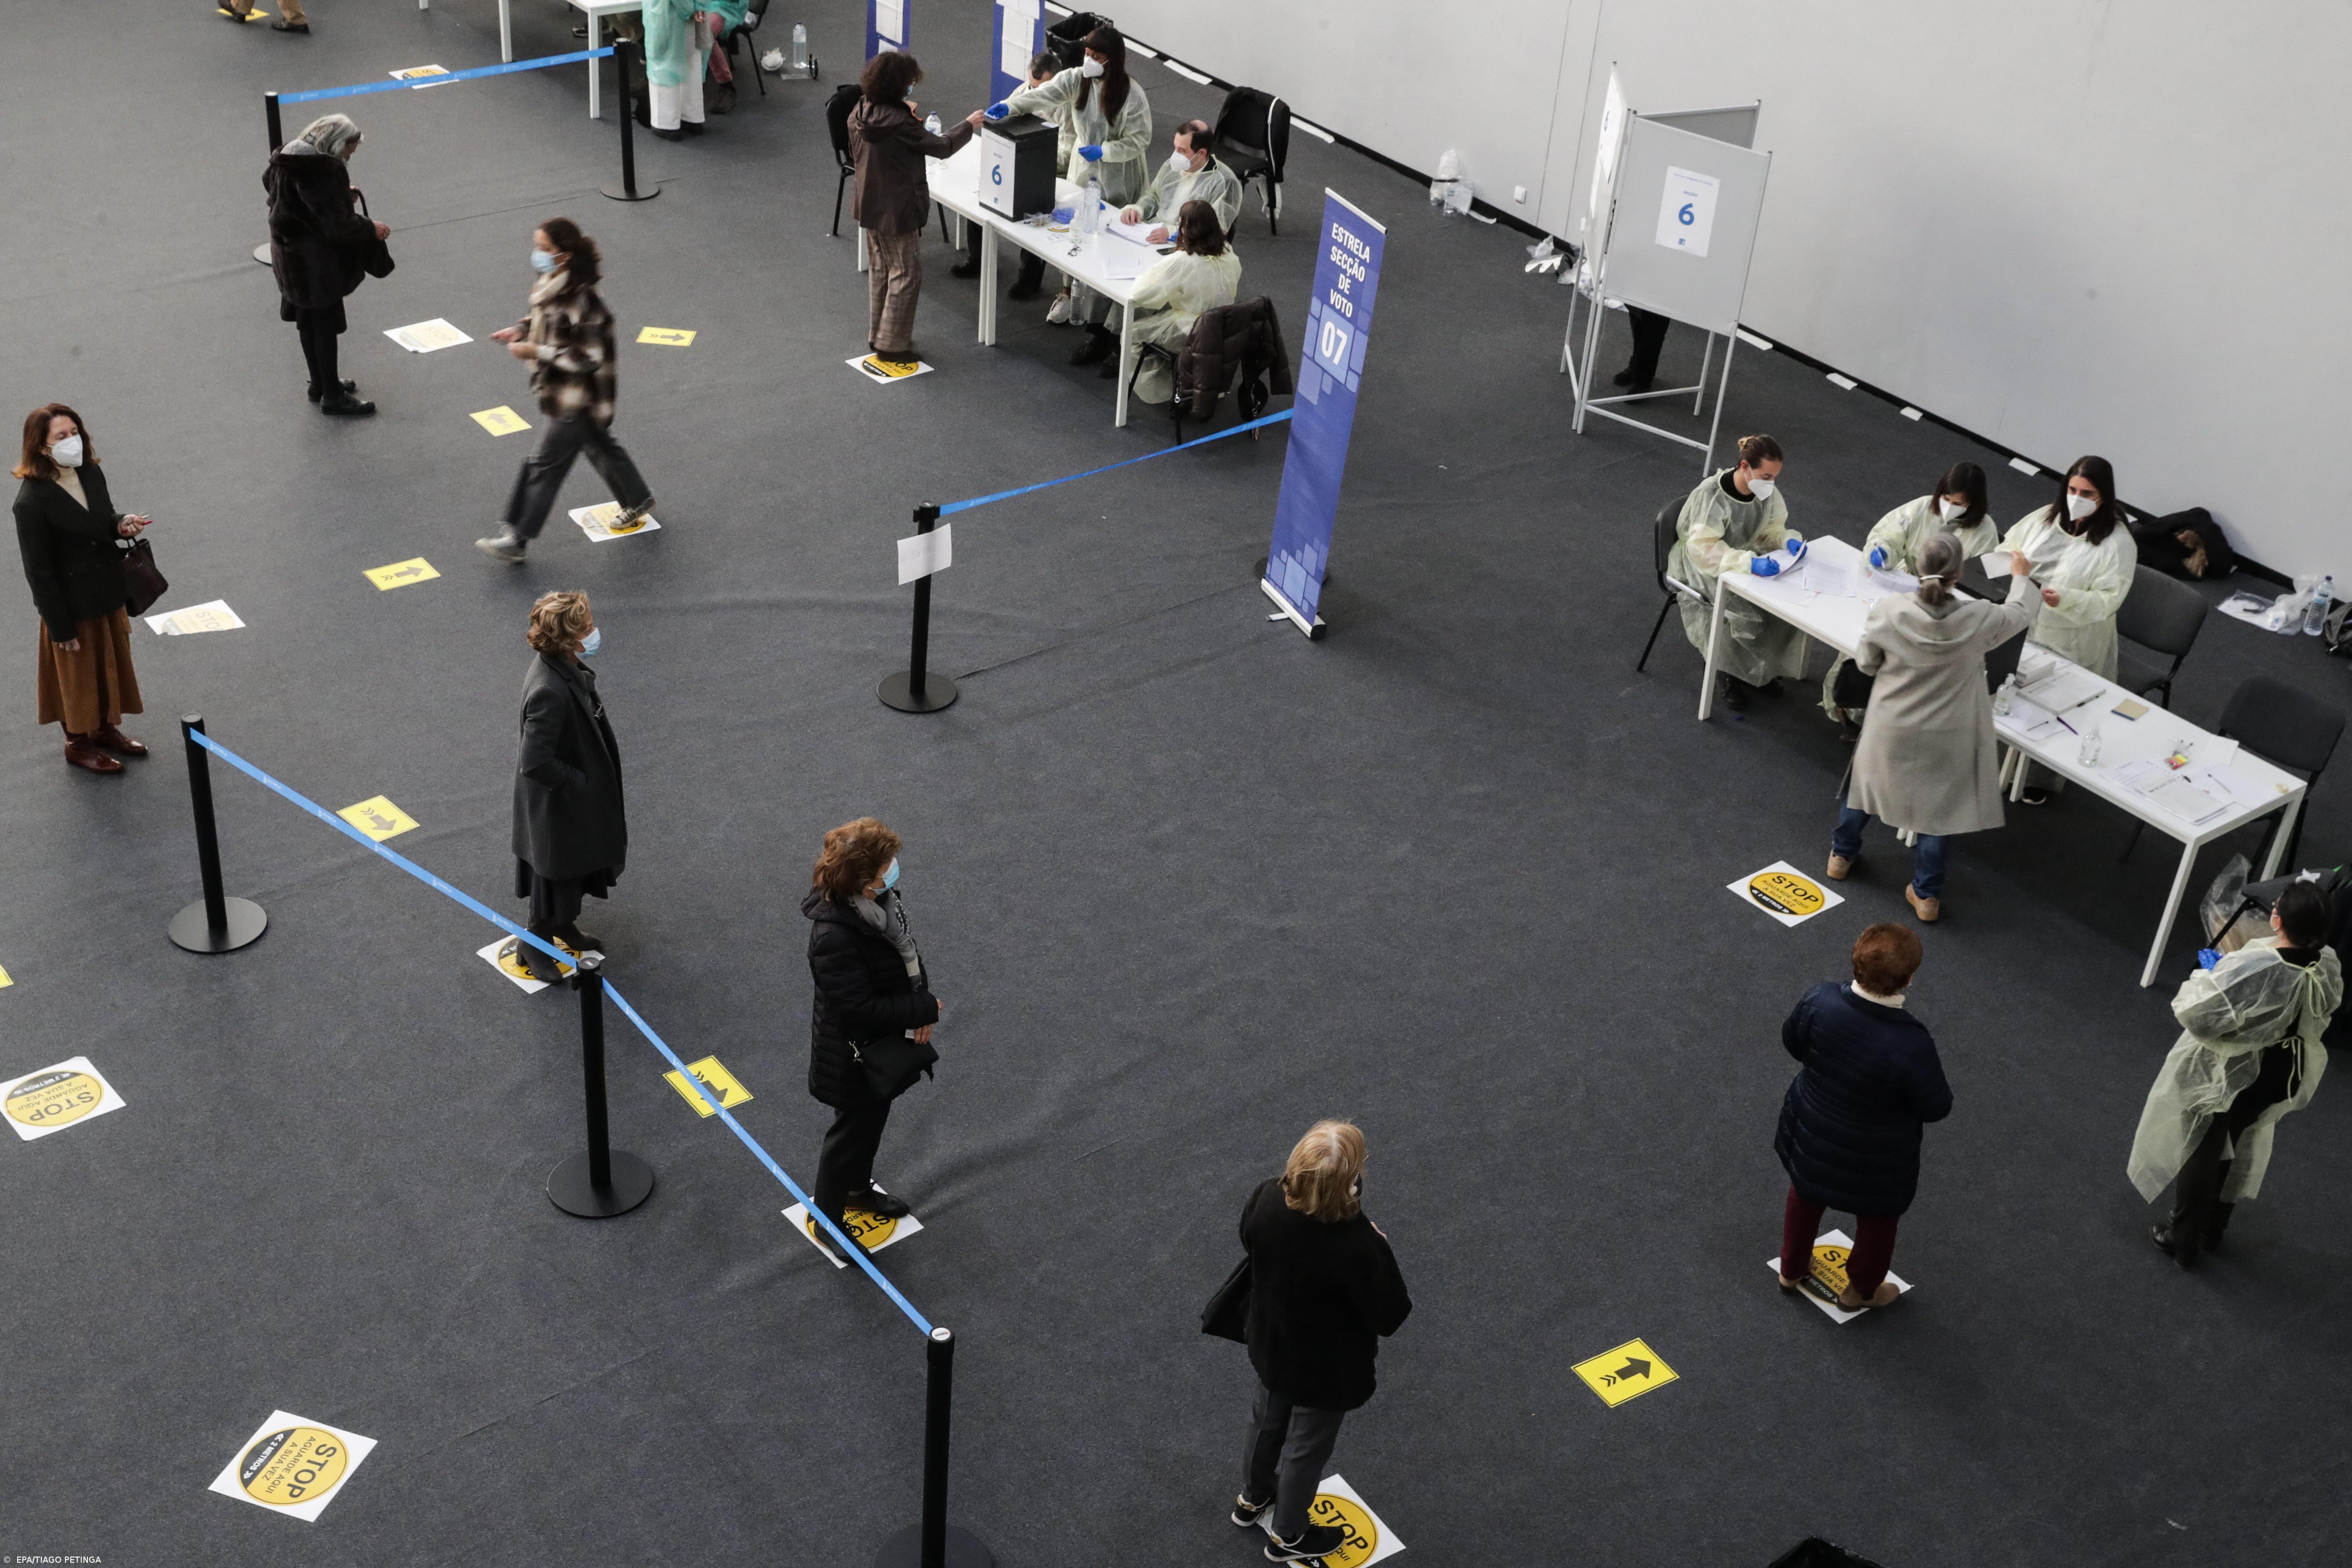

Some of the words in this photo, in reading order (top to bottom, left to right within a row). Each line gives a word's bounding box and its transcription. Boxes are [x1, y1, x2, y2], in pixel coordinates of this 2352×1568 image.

[992, 164, 1002, 185] 6
[1678, 203, 1695, 225] 6
[1331, 223, 1370, 263] ESTRELA
[1330, 246, 1366, 282] SECÇÃO
[1338, 274, 1351, 295] DE
[1330, 289, 1353, 318] VOTO
[1322, 321, 1348, 366] 07
[895, 362, 913, 370] OP
[196, 611, 225, 631] STO
[1761, 880, 1792, 900] AGUARDE
[1794, 899, 1809, 909] AQUI
[1769, 890, 1783, 900] SUA
[1783, 898, 1797, 908] VEZ
[1772, 876, 1819, 902] STOP
[1762, 895, 1783, 909] METROS
[24, 1078, 54, 1092] METROS
[43, 1083, 88, 1102] AGUARDE
[45, 1085, 65, 1094] SUA
[18, 1101, 40, 1111] AQUI
[29, 1091, 94, 1121] STOP
[1823, 1250, 1847, 1269] ST
[1809, 1278, 1833, 1298] METROS
[1818, 1271, 1833, 1284] SUA
[1834, 1282, 1843, 1292] VE
[250, 1445, 276, 1471] METROS
[275, 1448, 293, 1464] SUA
[284, 1436, 316, 1474] AGUARDE
[261, 1466, 280, 1481] VEZ
[287, 1443, 337, 1499] STOP
[265, 1475, 285, 1494] AQUI
[1314, 1500, 1369, 1550] STOP
[1336, 1548, 1351, 1561] QUI
